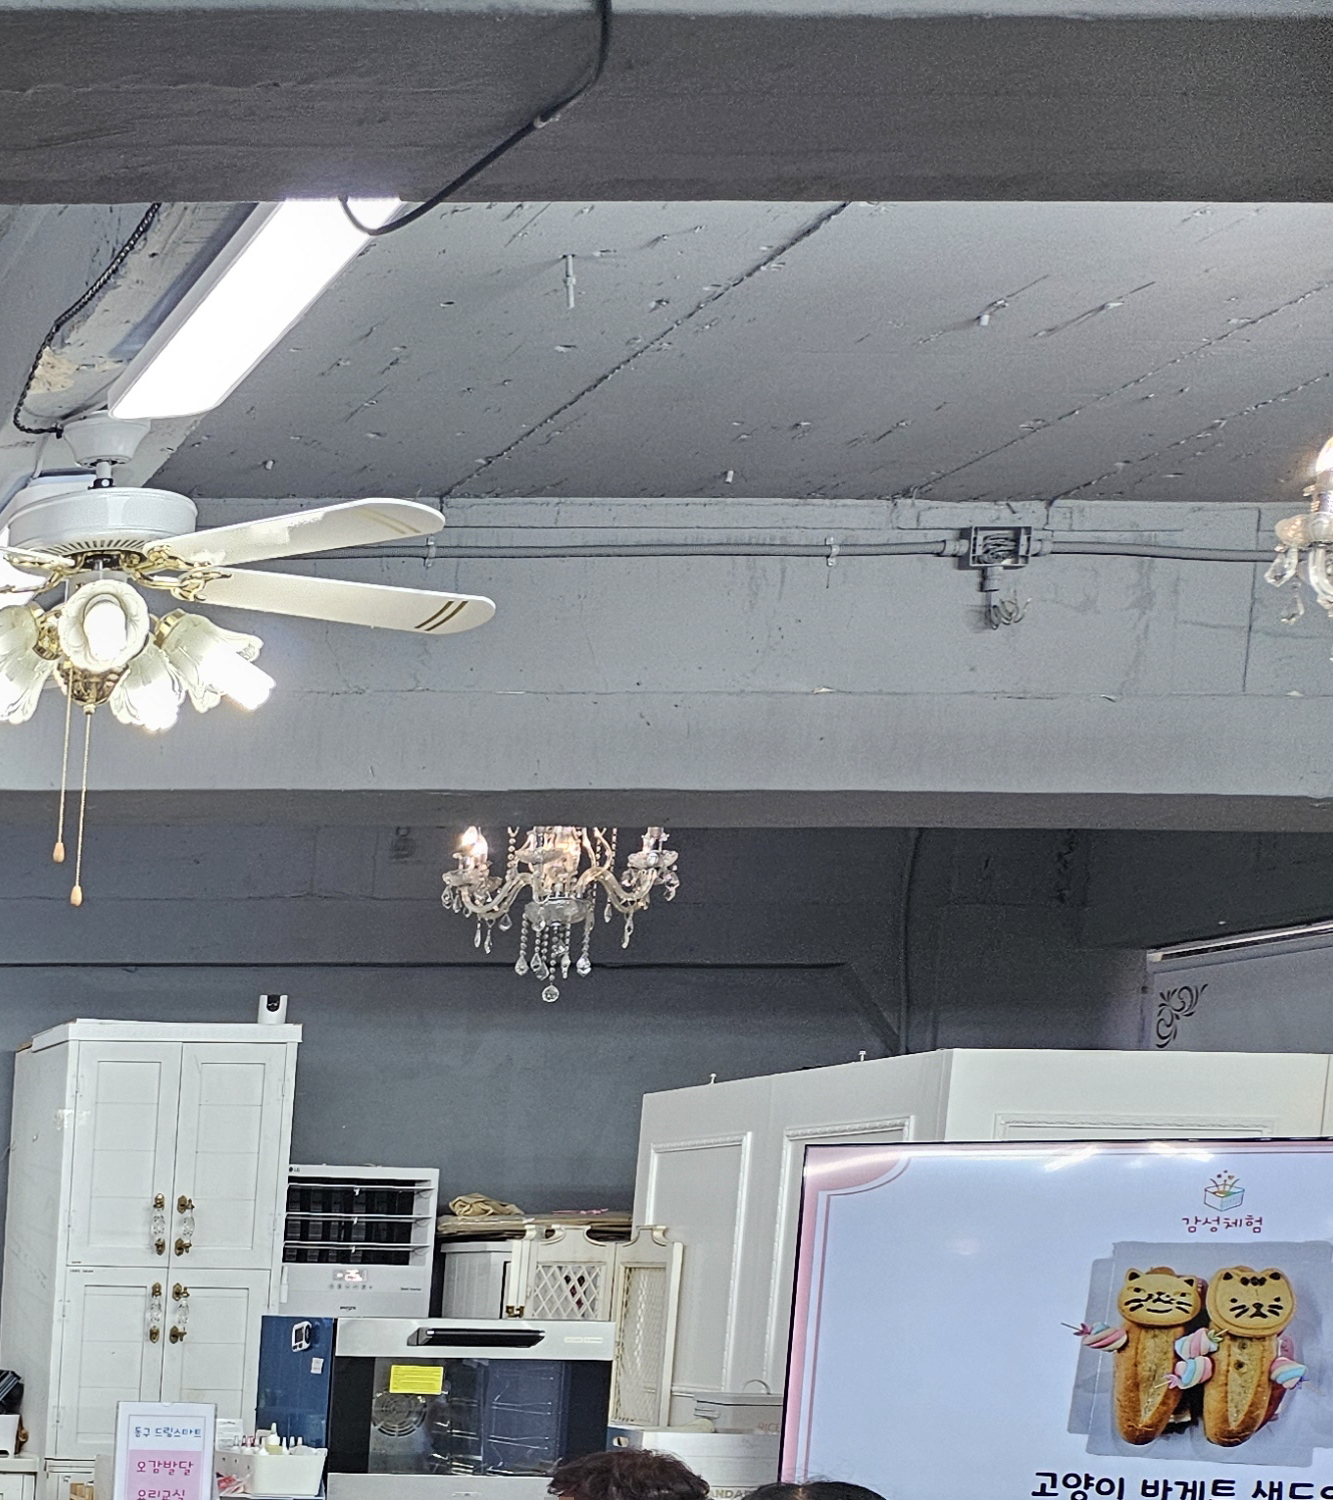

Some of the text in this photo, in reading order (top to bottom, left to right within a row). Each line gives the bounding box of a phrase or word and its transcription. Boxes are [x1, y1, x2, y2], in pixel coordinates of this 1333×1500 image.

[1182, 1215, 1263, 1233] 감성체험
[135, 1426, 150, 1437] 동구
[136, 1461, 194, 1476] 오감발달
